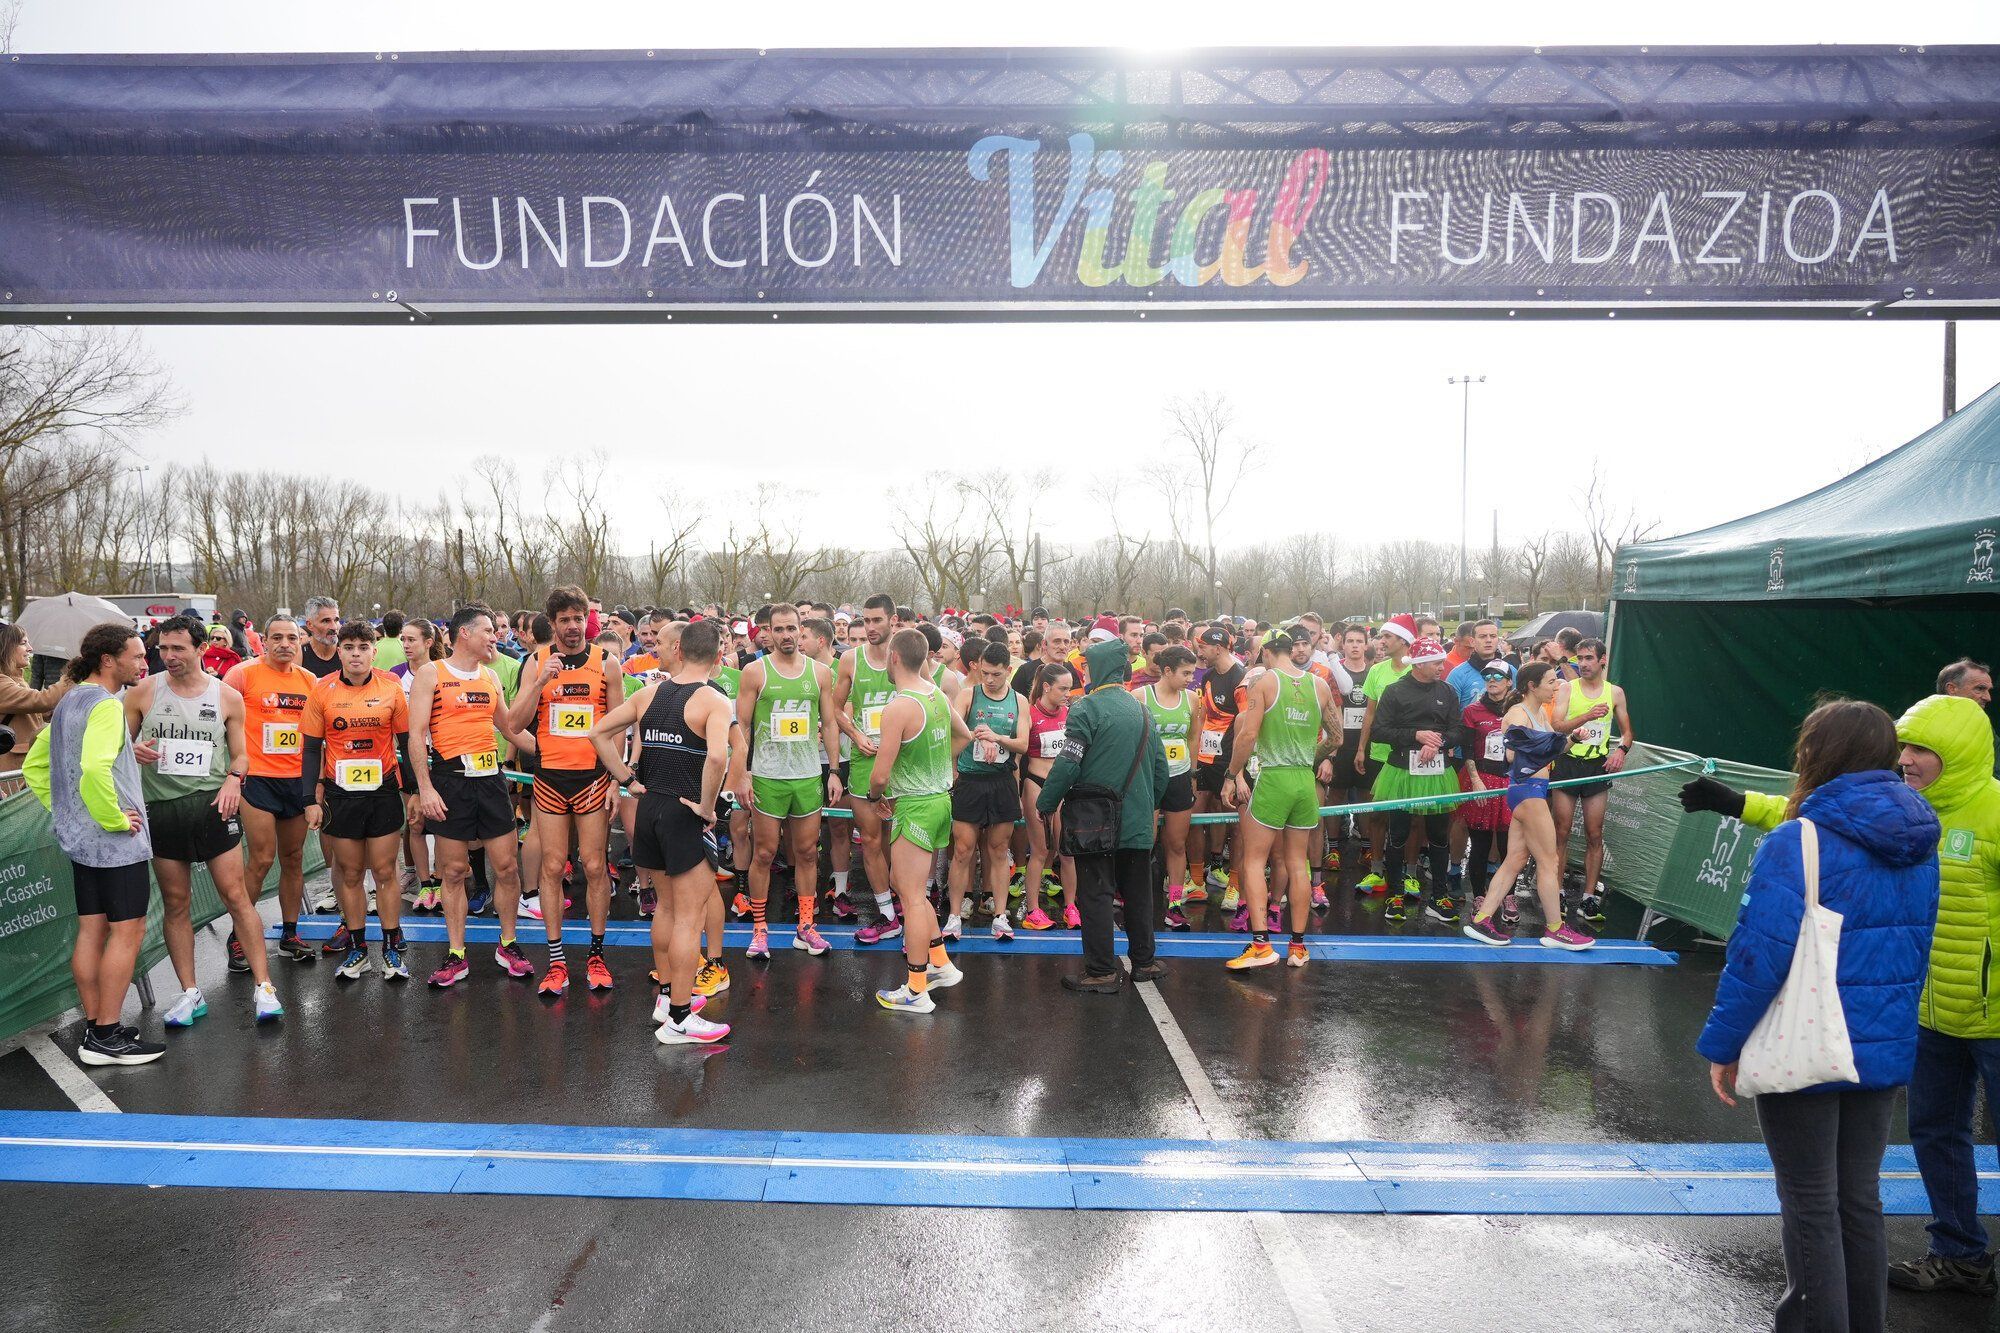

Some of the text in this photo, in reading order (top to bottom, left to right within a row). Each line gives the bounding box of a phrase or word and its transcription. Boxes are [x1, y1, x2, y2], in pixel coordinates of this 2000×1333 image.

[403, 132, 1900, 290] FUNDACIÓN Vital FUNDAZIOA
[564, 686, 589, 694] vibike
[772, 700, 812, 712] LEA
[1286, 706, 1310, 721] Vital
[565, 714, 585, 728] 24
[790, 721, 799, 734] 8
[1155, 723, 1188, 734] LEA
[280, 733, 297, 745] 20
[644, 729, 683, 744] Alimco
[1051, 739, 1066, 749] 66
[1204, 740, 1218, 749] 916
[174, 752, 203, 765] 821
[1169, 747, 1177, 759] 5
[478, 753, 493, 768] 19
[352, 769, 371, 782] 21
